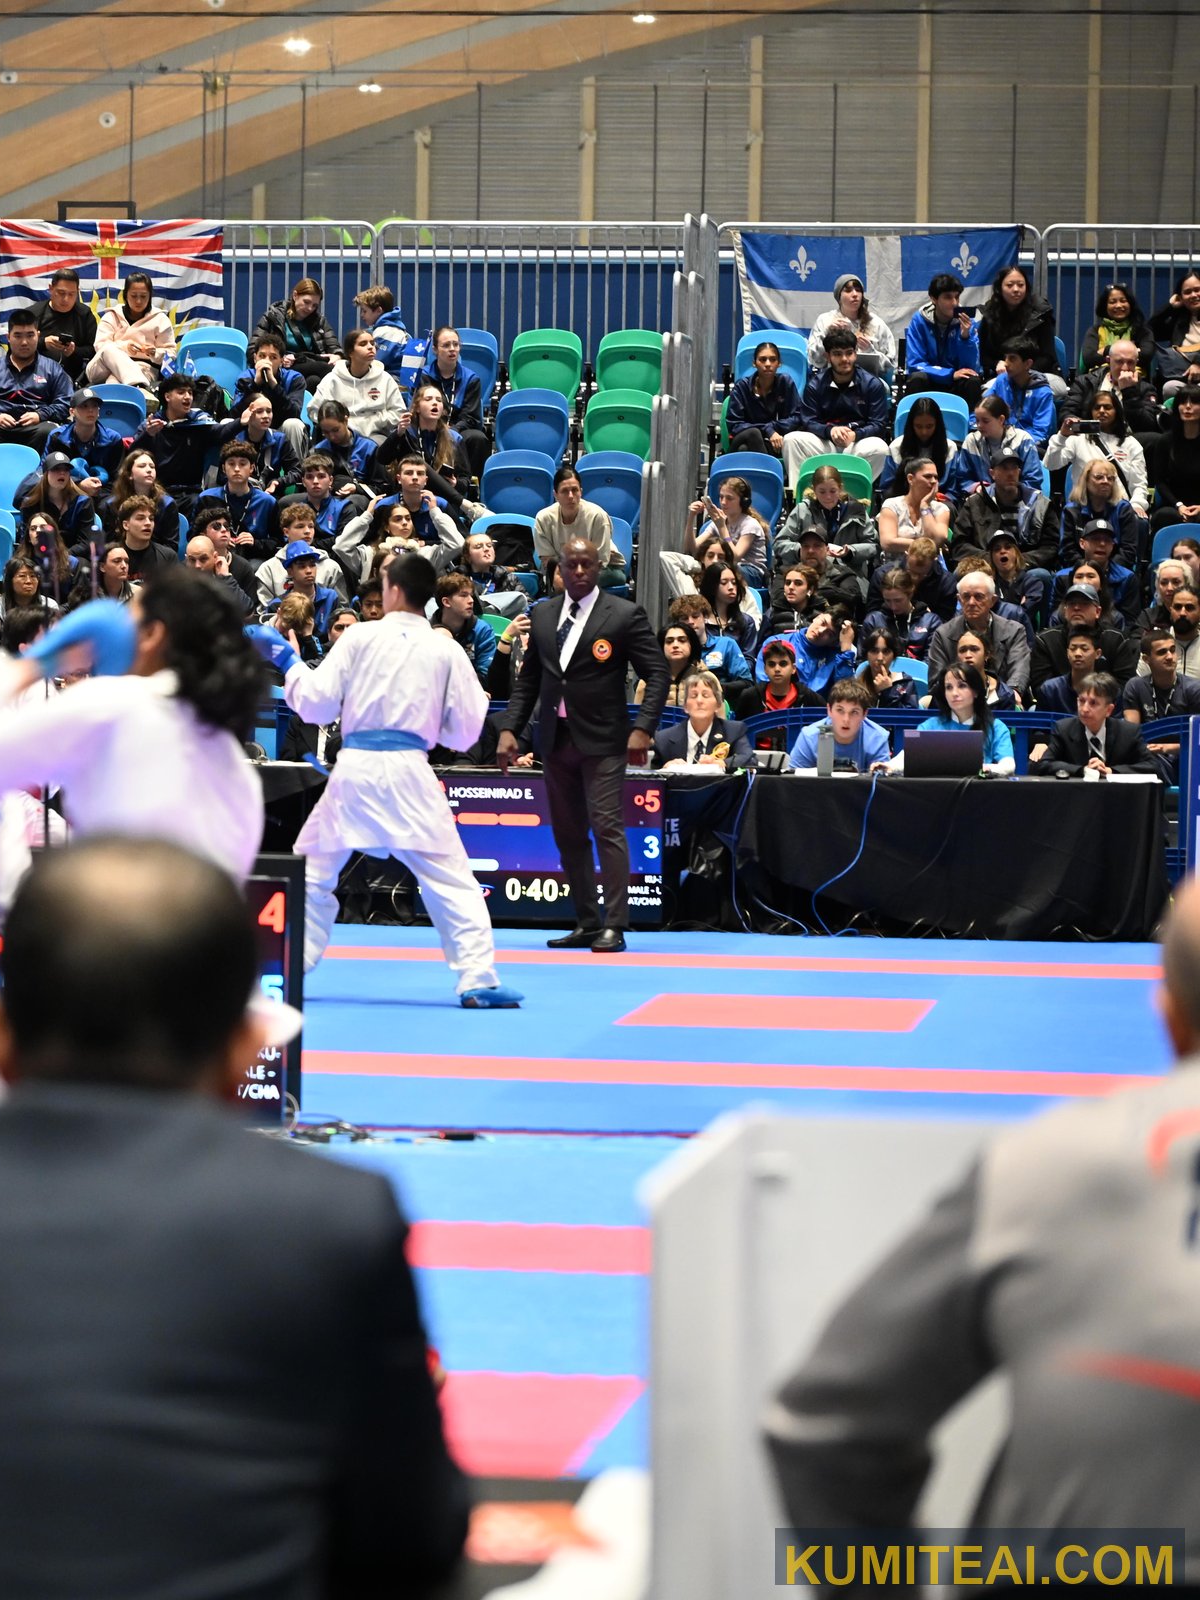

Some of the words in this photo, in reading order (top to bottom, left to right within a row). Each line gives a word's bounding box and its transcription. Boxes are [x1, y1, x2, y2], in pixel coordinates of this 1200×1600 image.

[524, 788, 534, 800] E.
[643, 835, 660, 859] 3
[258, 891, 285, 933] 4
